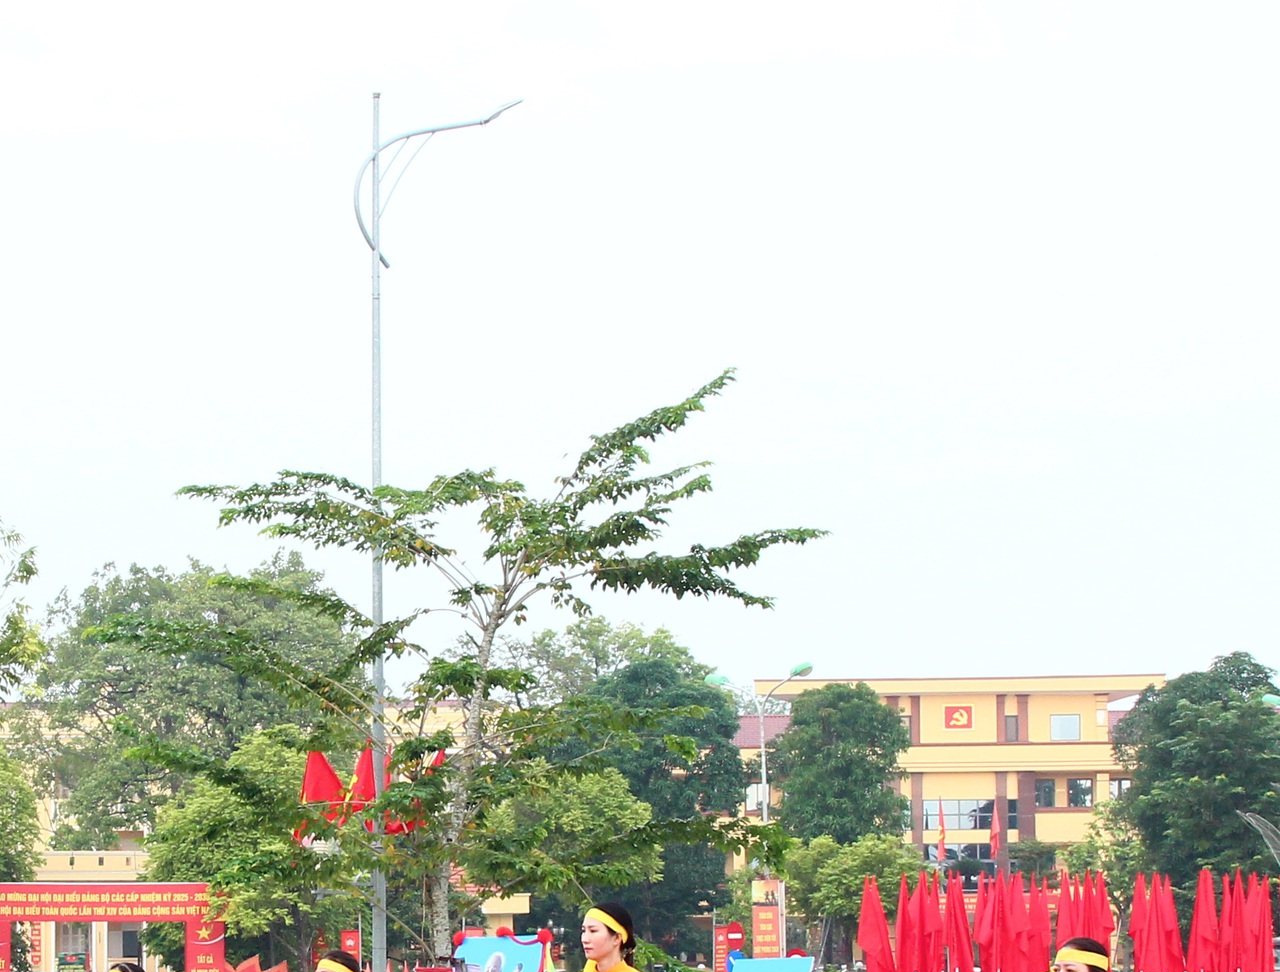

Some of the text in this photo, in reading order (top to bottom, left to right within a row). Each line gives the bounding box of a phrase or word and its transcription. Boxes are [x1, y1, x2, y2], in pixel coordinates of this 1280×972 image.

[7, 892, 27, 902] MỪNG
[28, 893, 40, 904] ĐẠI
[40, 892, 52, 904] HỘI
[53, 893, 64, 904] ĐẠI
[65, 891, 81, 902] BIỂU
[81, 891, 100, 902] ĐẢNG
[101, 892, 110, 904] BỘ
[111, 891, 124, 902] CÁC
[125, 890, 139, 902] CẤP
[140, 892, 162, 904] NHIỆM
[163, 891, 172, 902] KỲ
[173, 893, 189, 902] 2025
[0, 905, 11, 916] HỘI
[12, 906, 24, 917] ĐẠI
[25, 904, 41, 915] BIỂU
[42, 905, 59, 915] TOÀN
[60, 904, 78, 916] QUỐC
[79, 905, 92, 915] LẦN
[93, 906, 106, 915] THỨ
[106, 907, 117, 915] XIV
[118, 905, 132, 915] CỦA
[133, 905, 151, 915] ĐẢNG
[152, 905, 170, 917] CỘNG
[171, 904, 185, 915] SẢN
[186, 905, 200, 916] VIỆT
[201, 906, 210, 915] NA
[197, 953, 214, 964] TẤT CẢ
